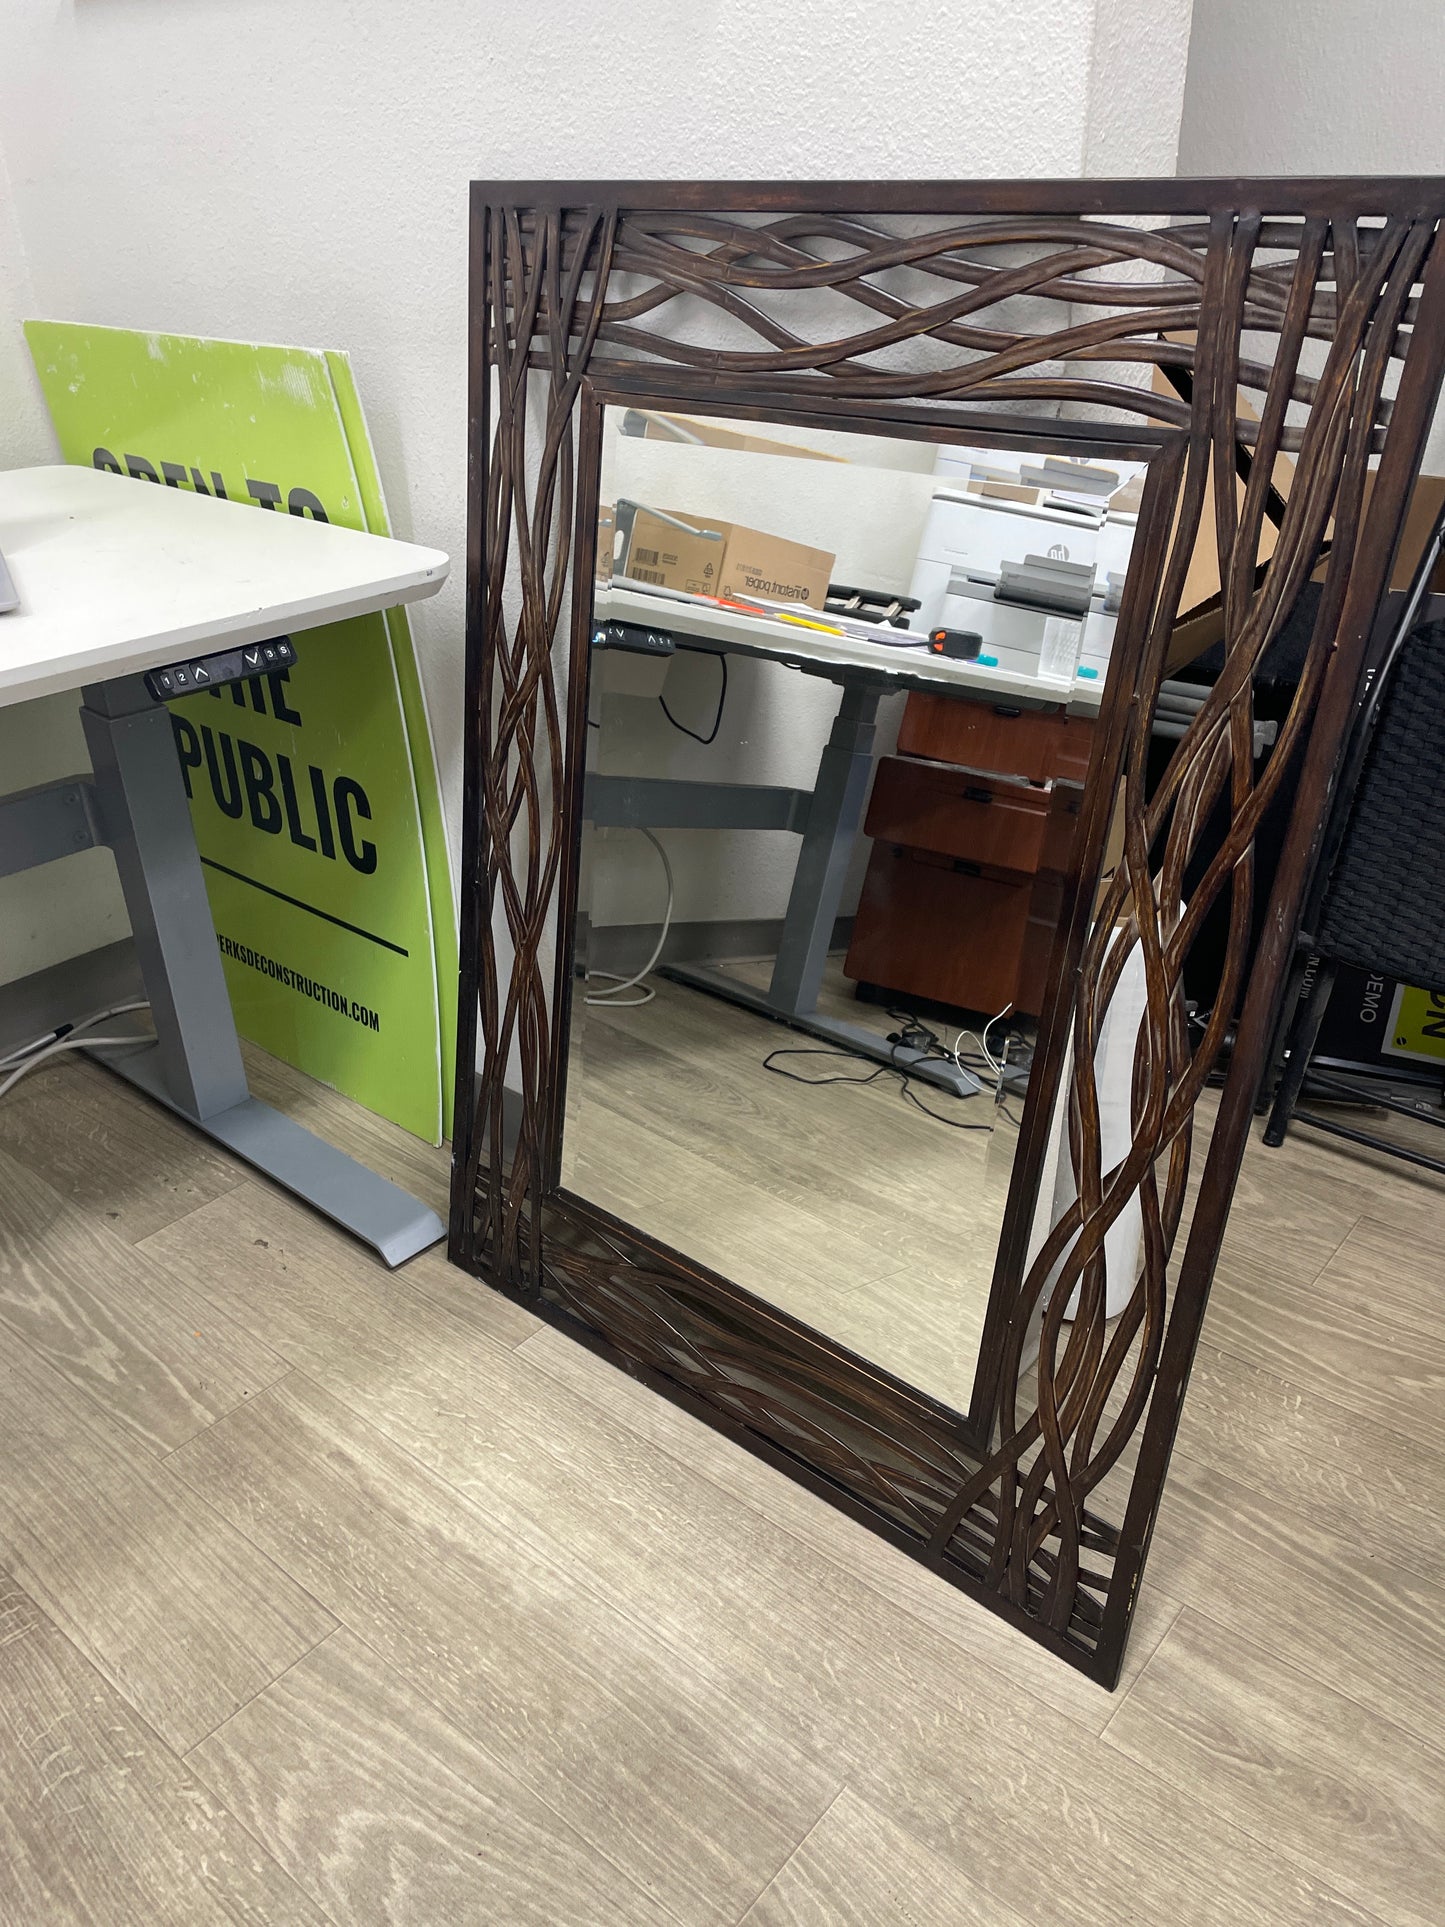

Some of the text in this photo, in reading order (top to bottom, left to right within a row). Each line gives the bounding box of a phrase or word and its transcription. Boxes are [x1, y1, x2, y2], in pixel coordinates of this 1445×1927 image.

[164, 646, 287, 685] 1 2 3 S
[169, 712, 378, 875] PUBLIC
[217, 934, 380, 1033] ERKSDECONSTRUCTION.COM
[1300, 953, 1321, 999] N.COM
